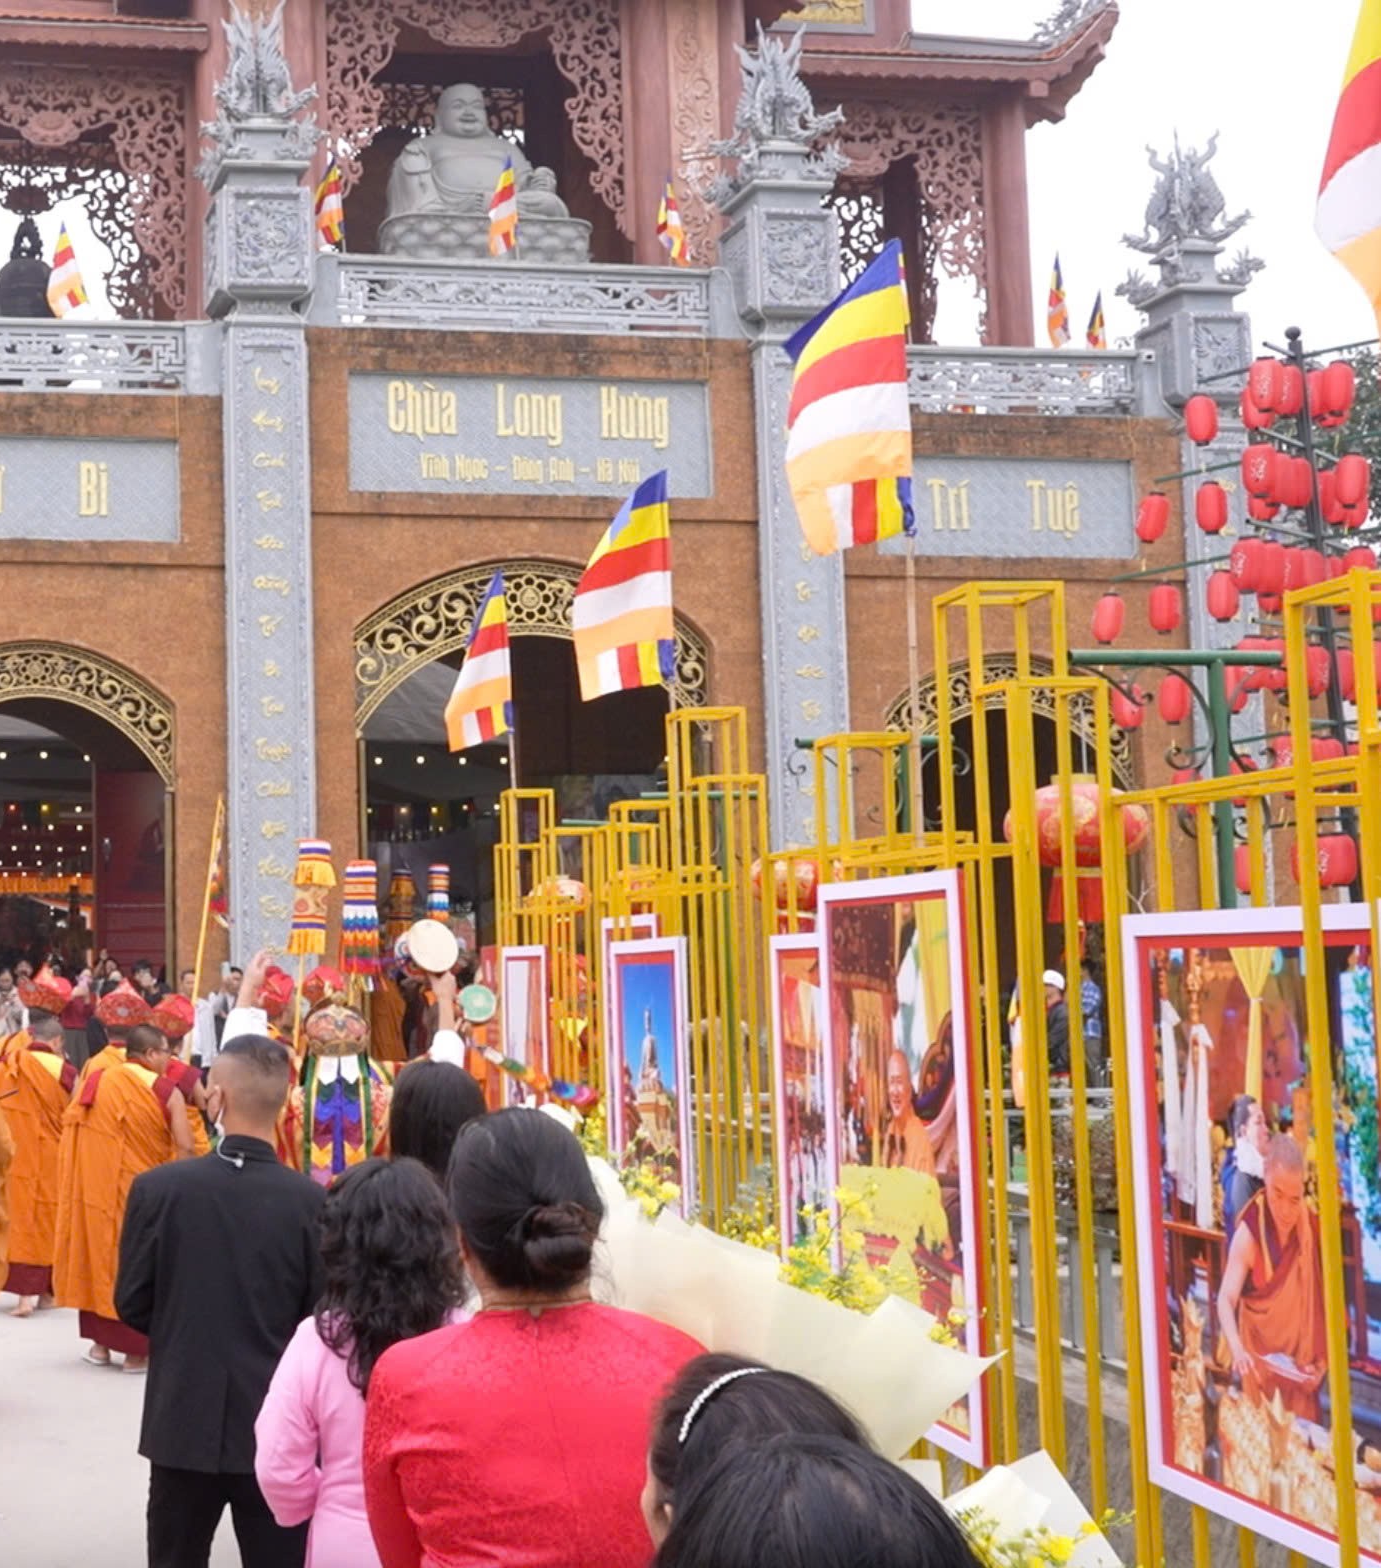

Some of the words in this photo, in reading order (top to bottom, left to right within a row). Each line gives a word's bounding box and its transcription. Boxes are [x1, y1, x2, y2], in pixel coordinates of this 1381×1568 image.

[387, 380, 458, 443] Chùa
[496, 383, 563, 447] Long
[599, 385, 669, 449] Hưng
[79, 460, 108, 516] Bi
[420, 452, 449, 481] Vĩnh
[455, 453, 489, 482] Ngọc
[512, 454, 543, 484] Đông
[549, 456, 574, 483] Anh
[596, 456, 613, 483] Hà
[619, 456, 640, 484] Nội
[927, 478, 970, 531] Trí
[1025, 479, 1080, 539] Tuệ
